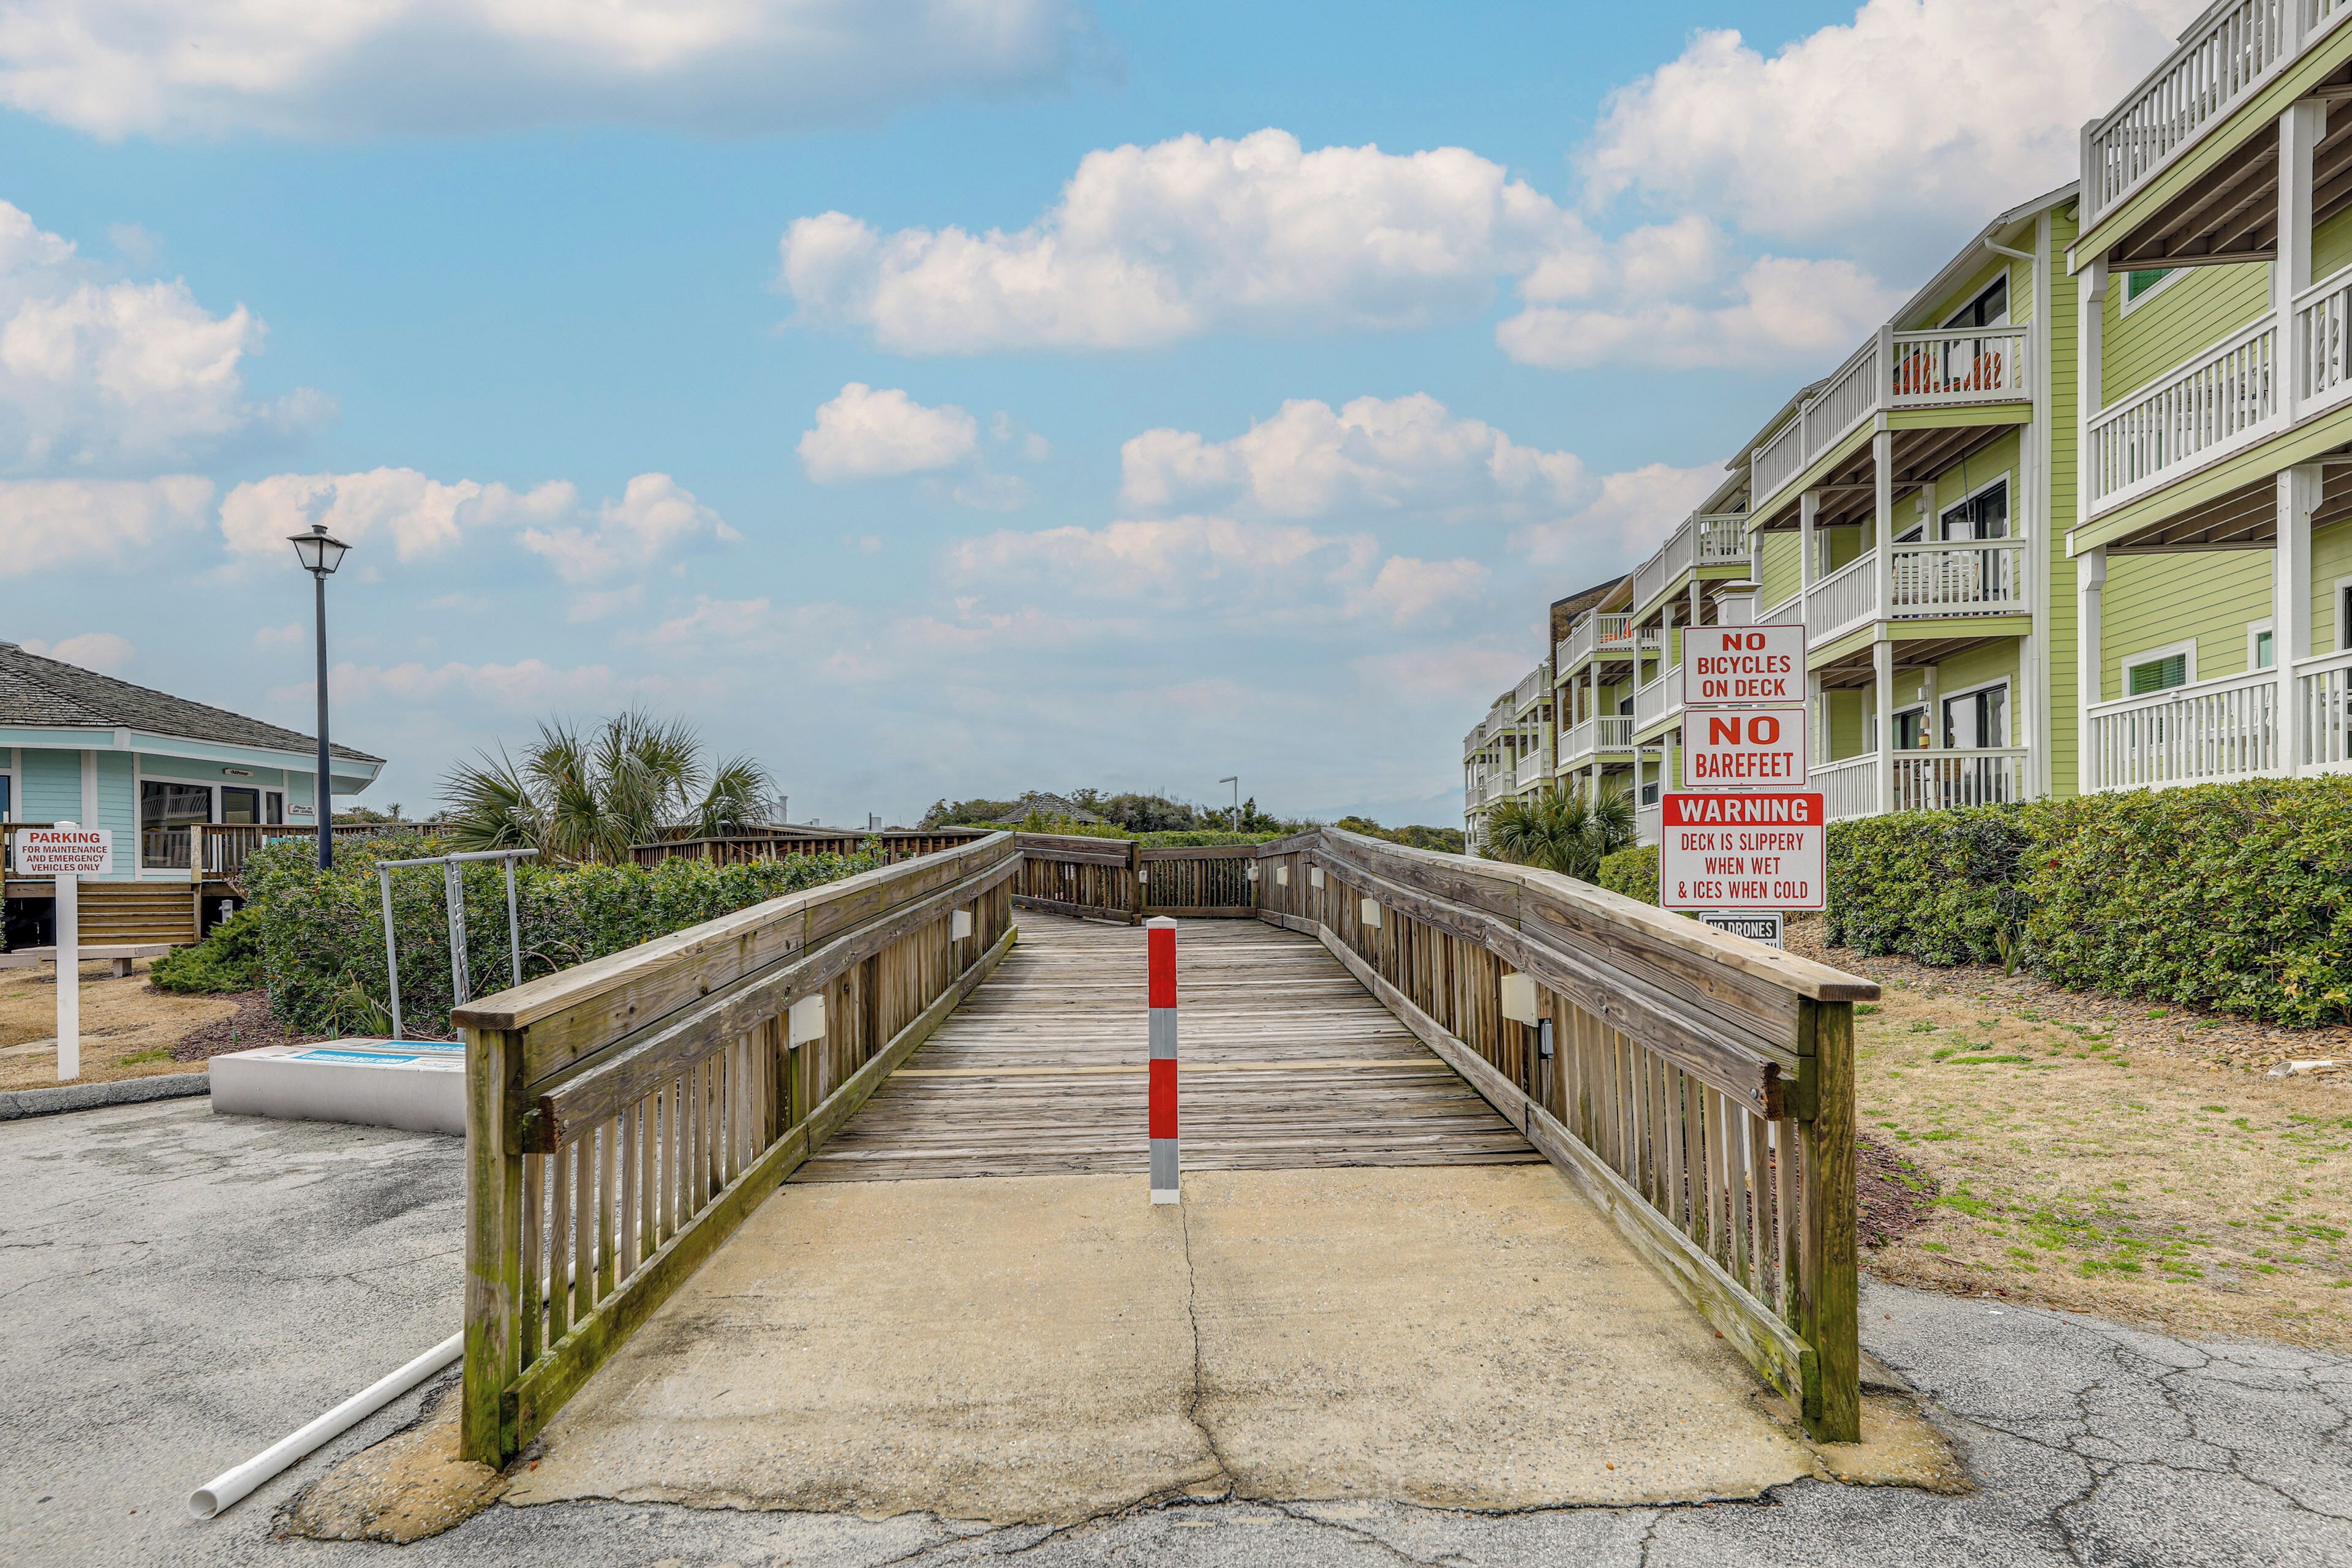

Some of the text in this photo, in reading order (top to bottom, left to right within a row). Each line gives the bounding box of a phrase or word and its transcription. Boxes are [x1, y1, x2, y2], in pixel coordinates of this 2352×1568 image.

[1723, 633, 1765, 651] NO
[1698, 656, 1790, 674] BICYCLES
[1703, 679, 1785, 697] ON DECK
[1709, 716, 1780, 745] NO
[1696, 752, 1793, 778] BAREFEET
[1678, 799, 1807, 821] WARNING
[30, 832, 100, 843] PARKING
[1681, 833, 1803, 851] DECK IS SLIPPERY
[1706, 858, 1780, 875] WHEN WET
[1678, 881, 1807, 899] & ICES WHEN COLD
[1727, 921, 1773, 938] DRONES
